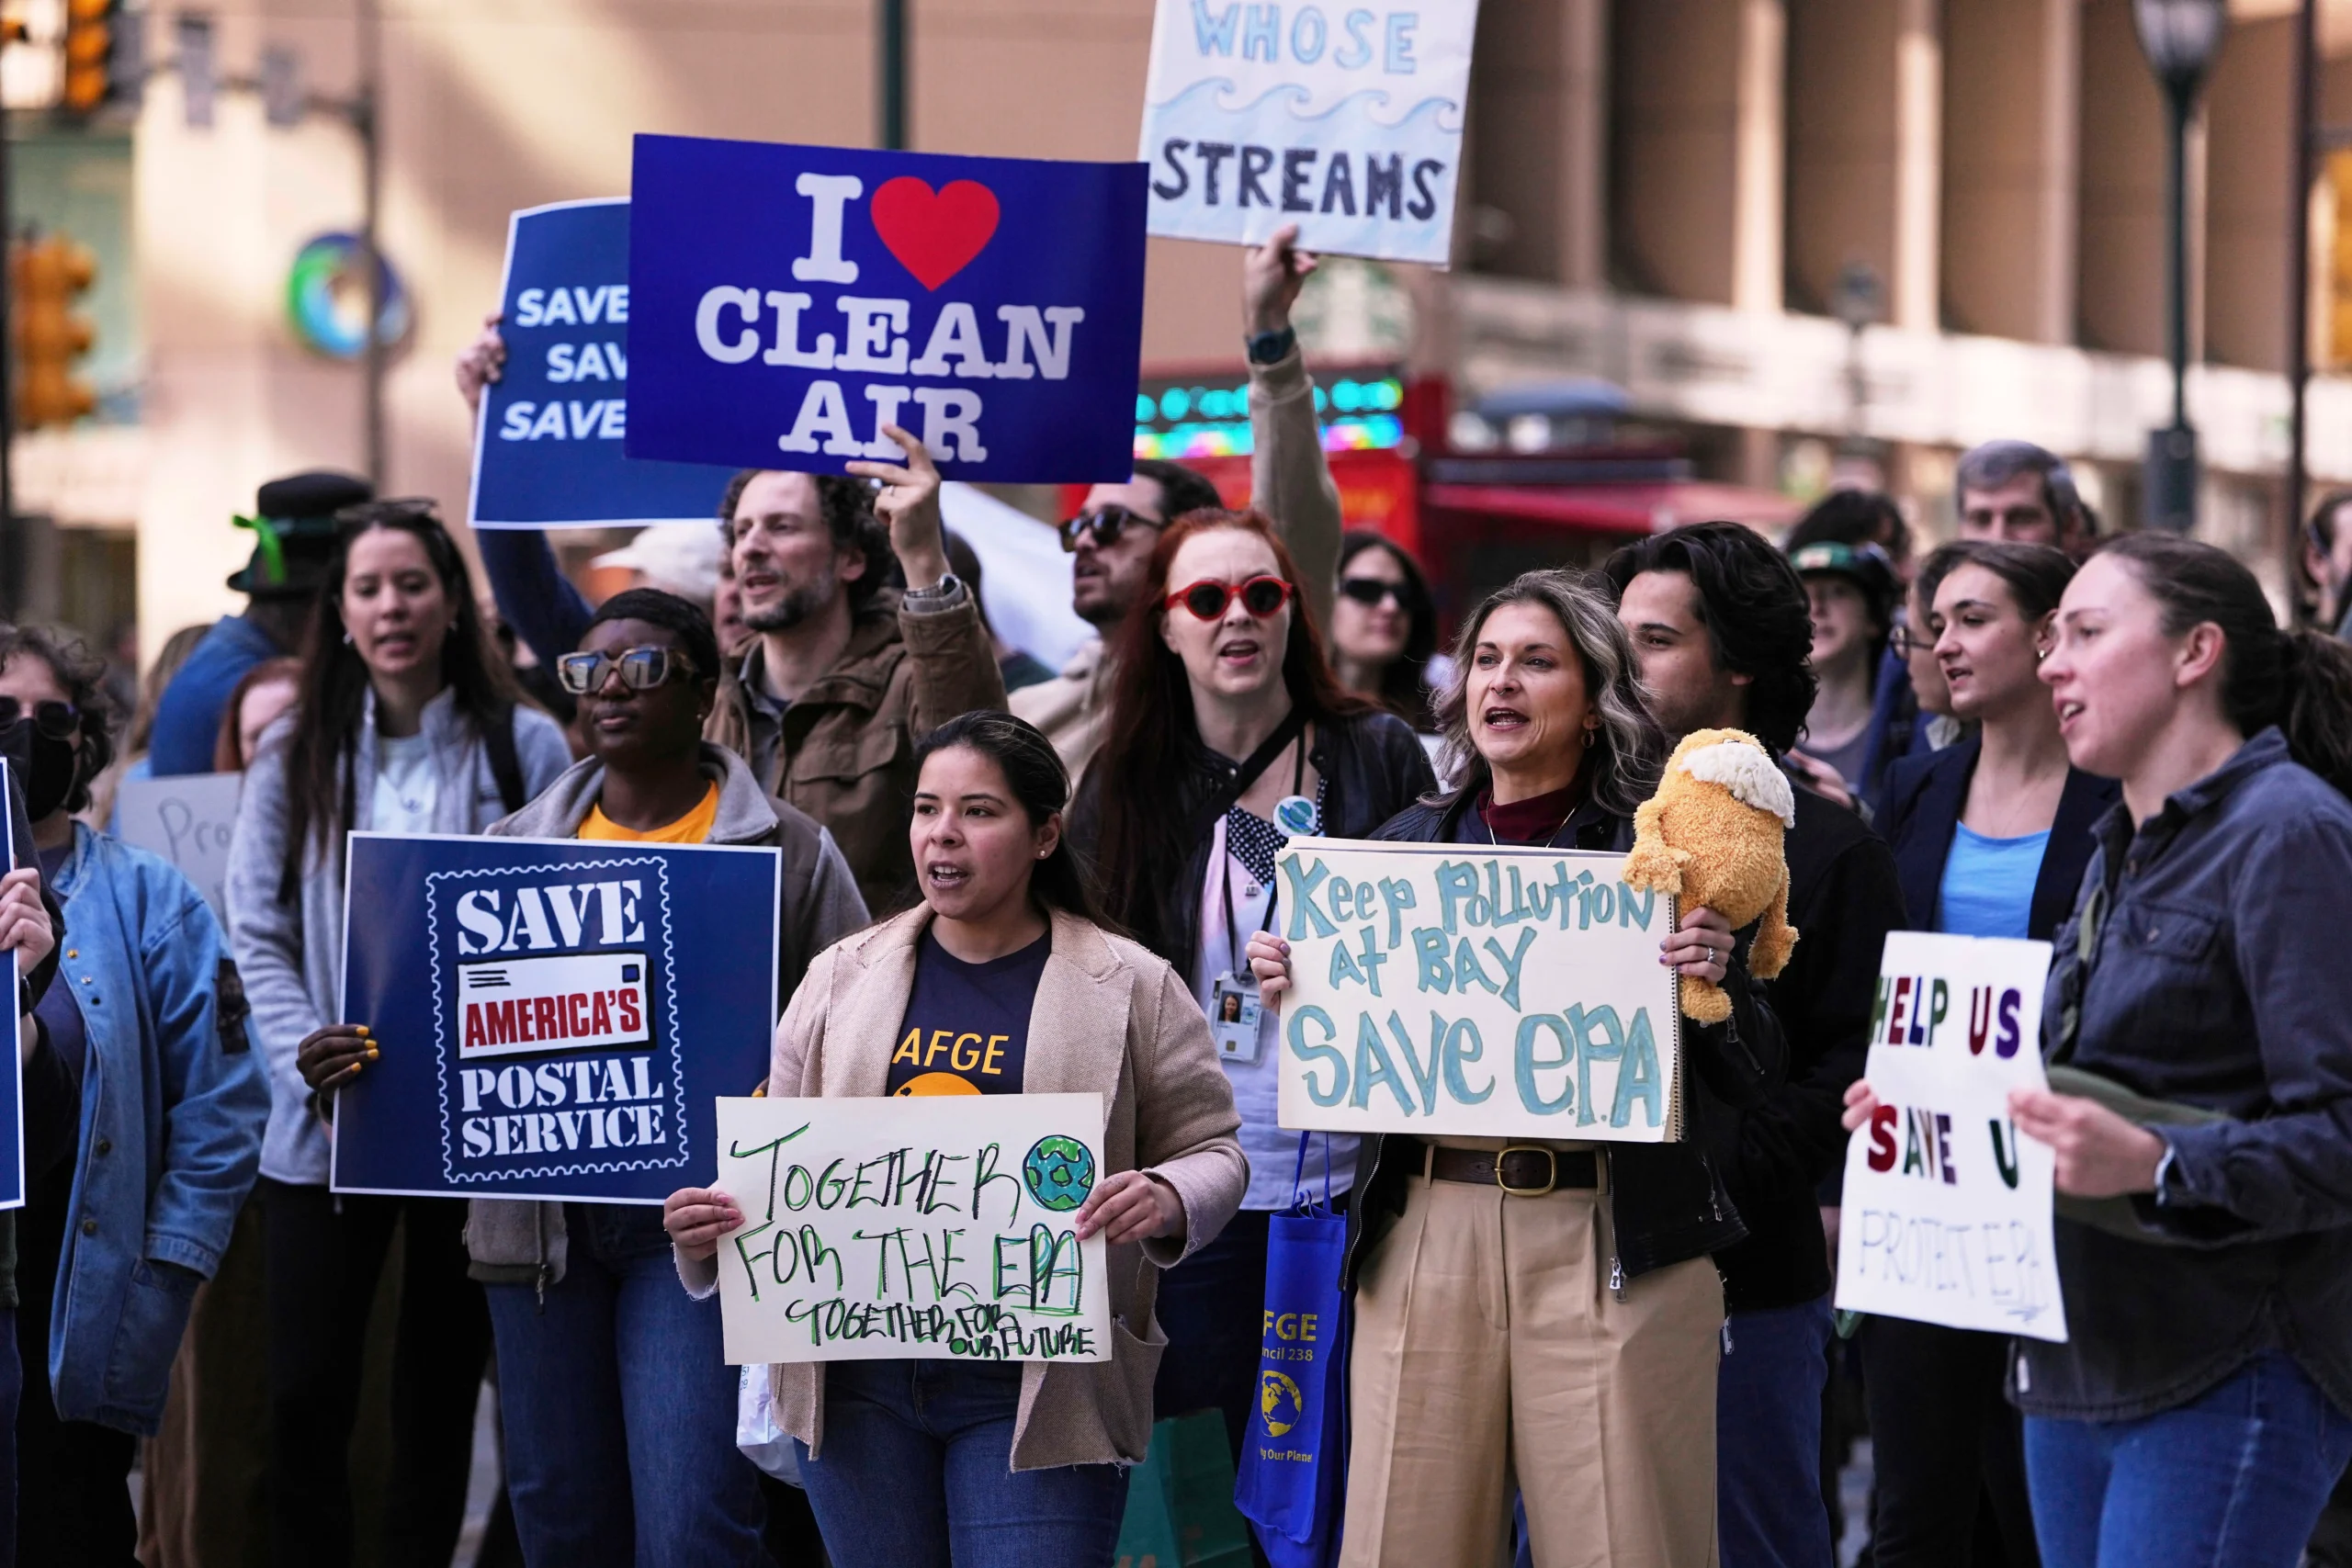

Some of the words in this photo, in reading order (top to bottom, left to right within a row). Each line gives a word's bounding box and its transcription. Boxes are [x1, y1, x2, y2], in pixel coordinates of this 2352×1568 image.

[1192, 0, 1419, 74] WHOSE
[1151, 138, 1446, 221] STREAMS
[792, 172, 863, 285] I
[515, 284, 629, 327] SAVE
[695, 285, 1085, 379] CLEAN
[499, 399, 627, 441] SAVE
[778, 379, 988, 463] AIR
[456, 879, 646, 955] SAVE
[1278, 852, 1416, 950] Keep
[1412, 925, 1538, 1013] BAY
[464, 987, 642, 1048] AMERICA'S
[891, 1027, 1010, 1076] AFGE
[1866, 976, 1948, 1048] HELP
[1969, 985, 2021, 1060] US
[459, 1056, 664, 1112] POSTAL
[461, 1104, 666, 1158] SERVICE
[1868, 1104, 1958, 1186] SAVE
[729, 1122, 1021, 1228] TOGETHER
[734, 1220, 843, 1302] FOR
[853, 1227, 978, 1303] THE
[993, 1222, 1084, 1315] EPA
[785, 1297, 956, 1348] TOGETHER
[955, 1303, 1021, 1338] FOR
[949, 1335, 1001, 1361] OUR
[1000, 1322, 1098, 1359] FUTURE
[1288, 1348, 1314, 1361] 238
[1267, 1449, 1285, 1461] Our
